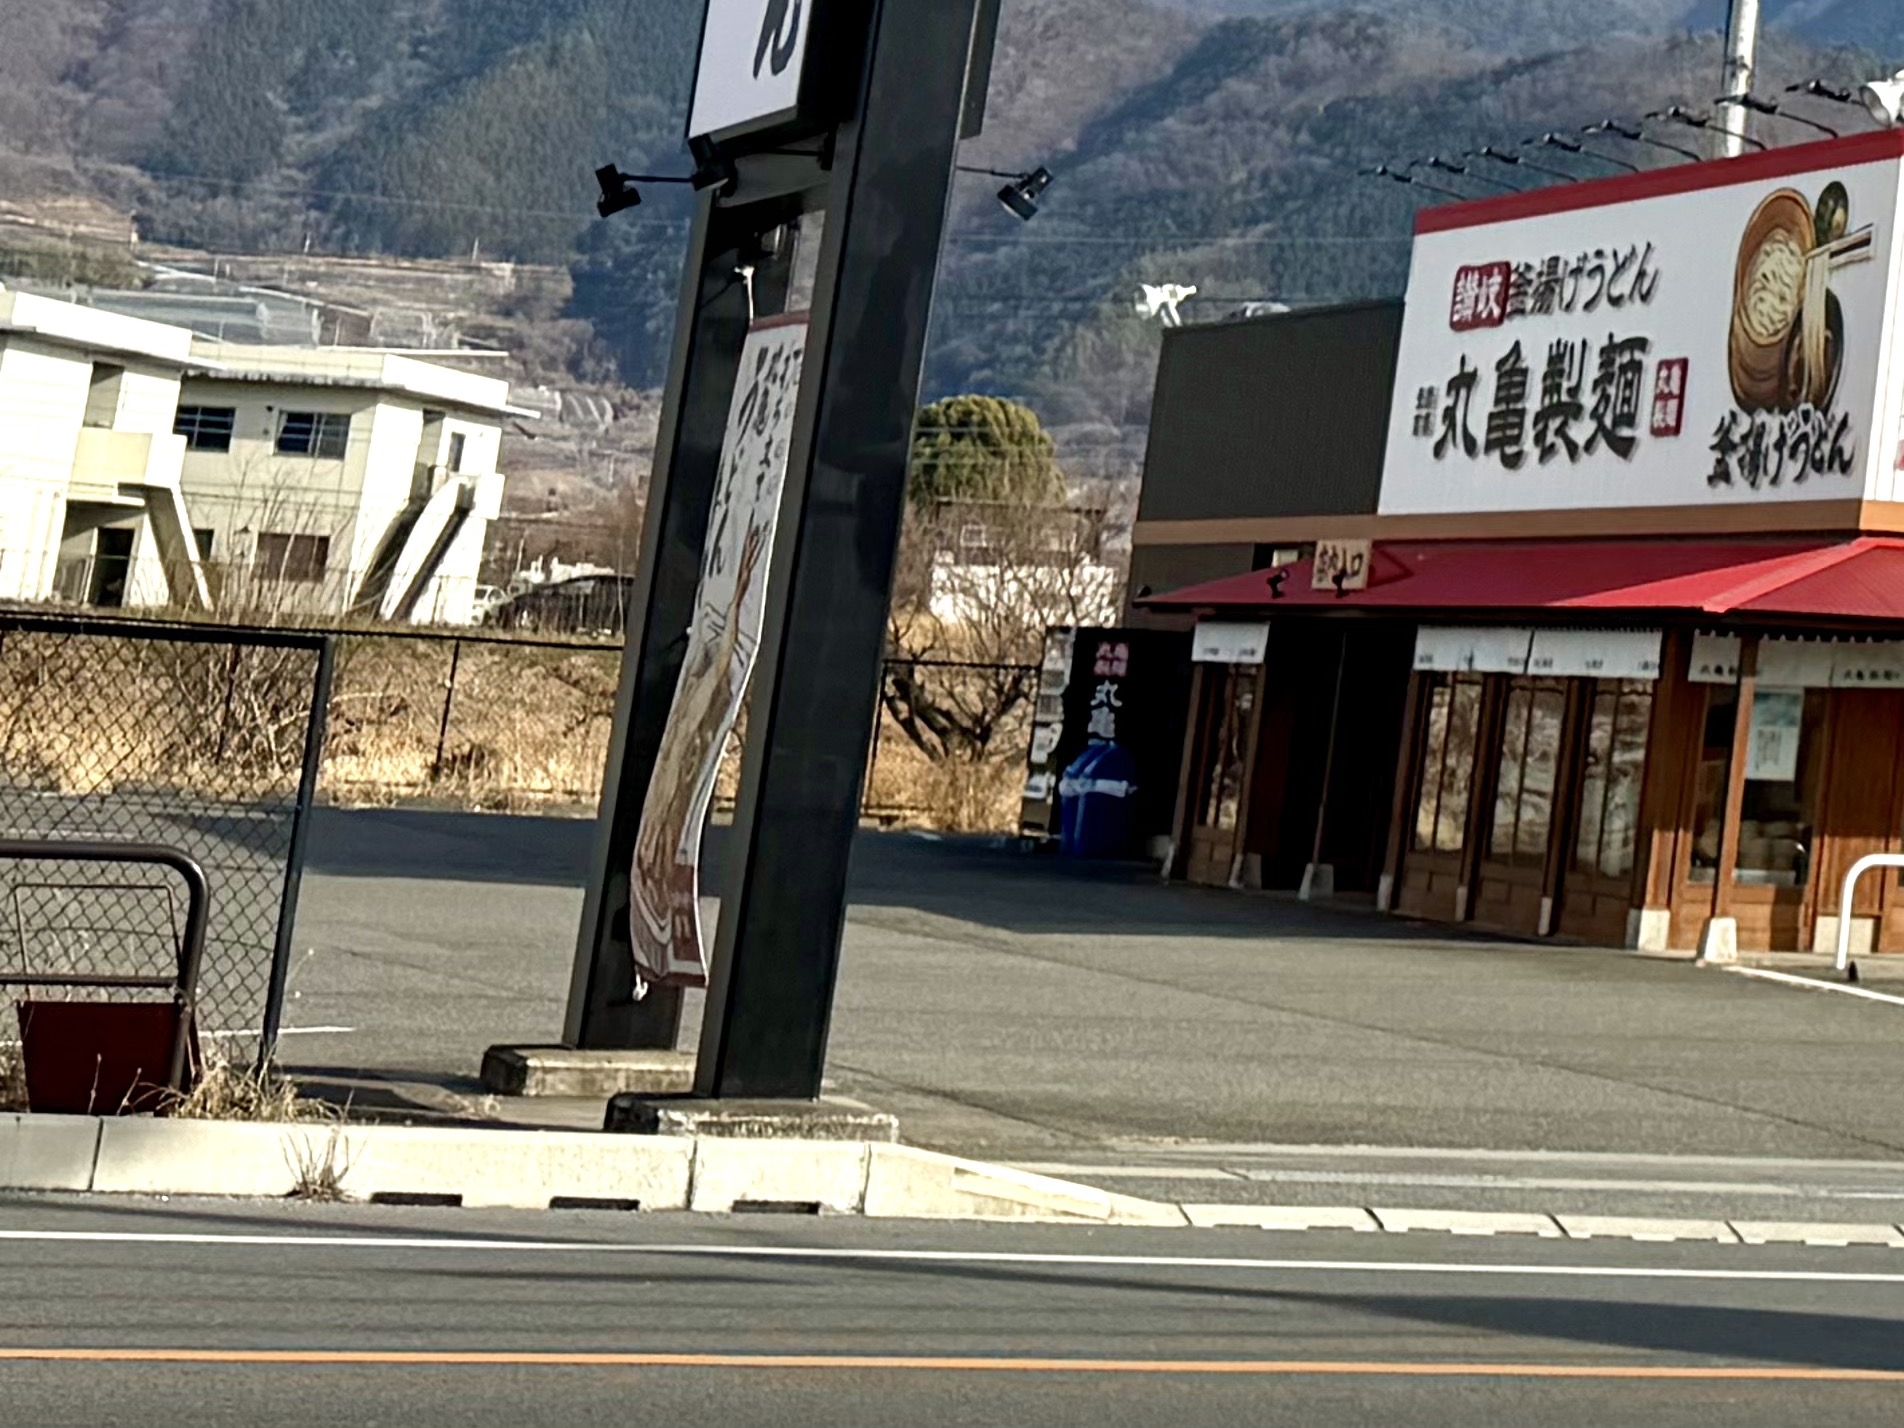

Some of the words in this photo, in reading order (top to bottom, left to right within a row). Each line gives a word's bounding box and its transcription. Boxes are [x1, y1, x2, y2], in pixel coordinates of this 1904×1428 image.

[1451, 269, 1507, 324] 讃岐
[1507, 241, 1661, 322] 釜揚げうどん
[1432, 332, 1650, 472] 丸亀製麺
